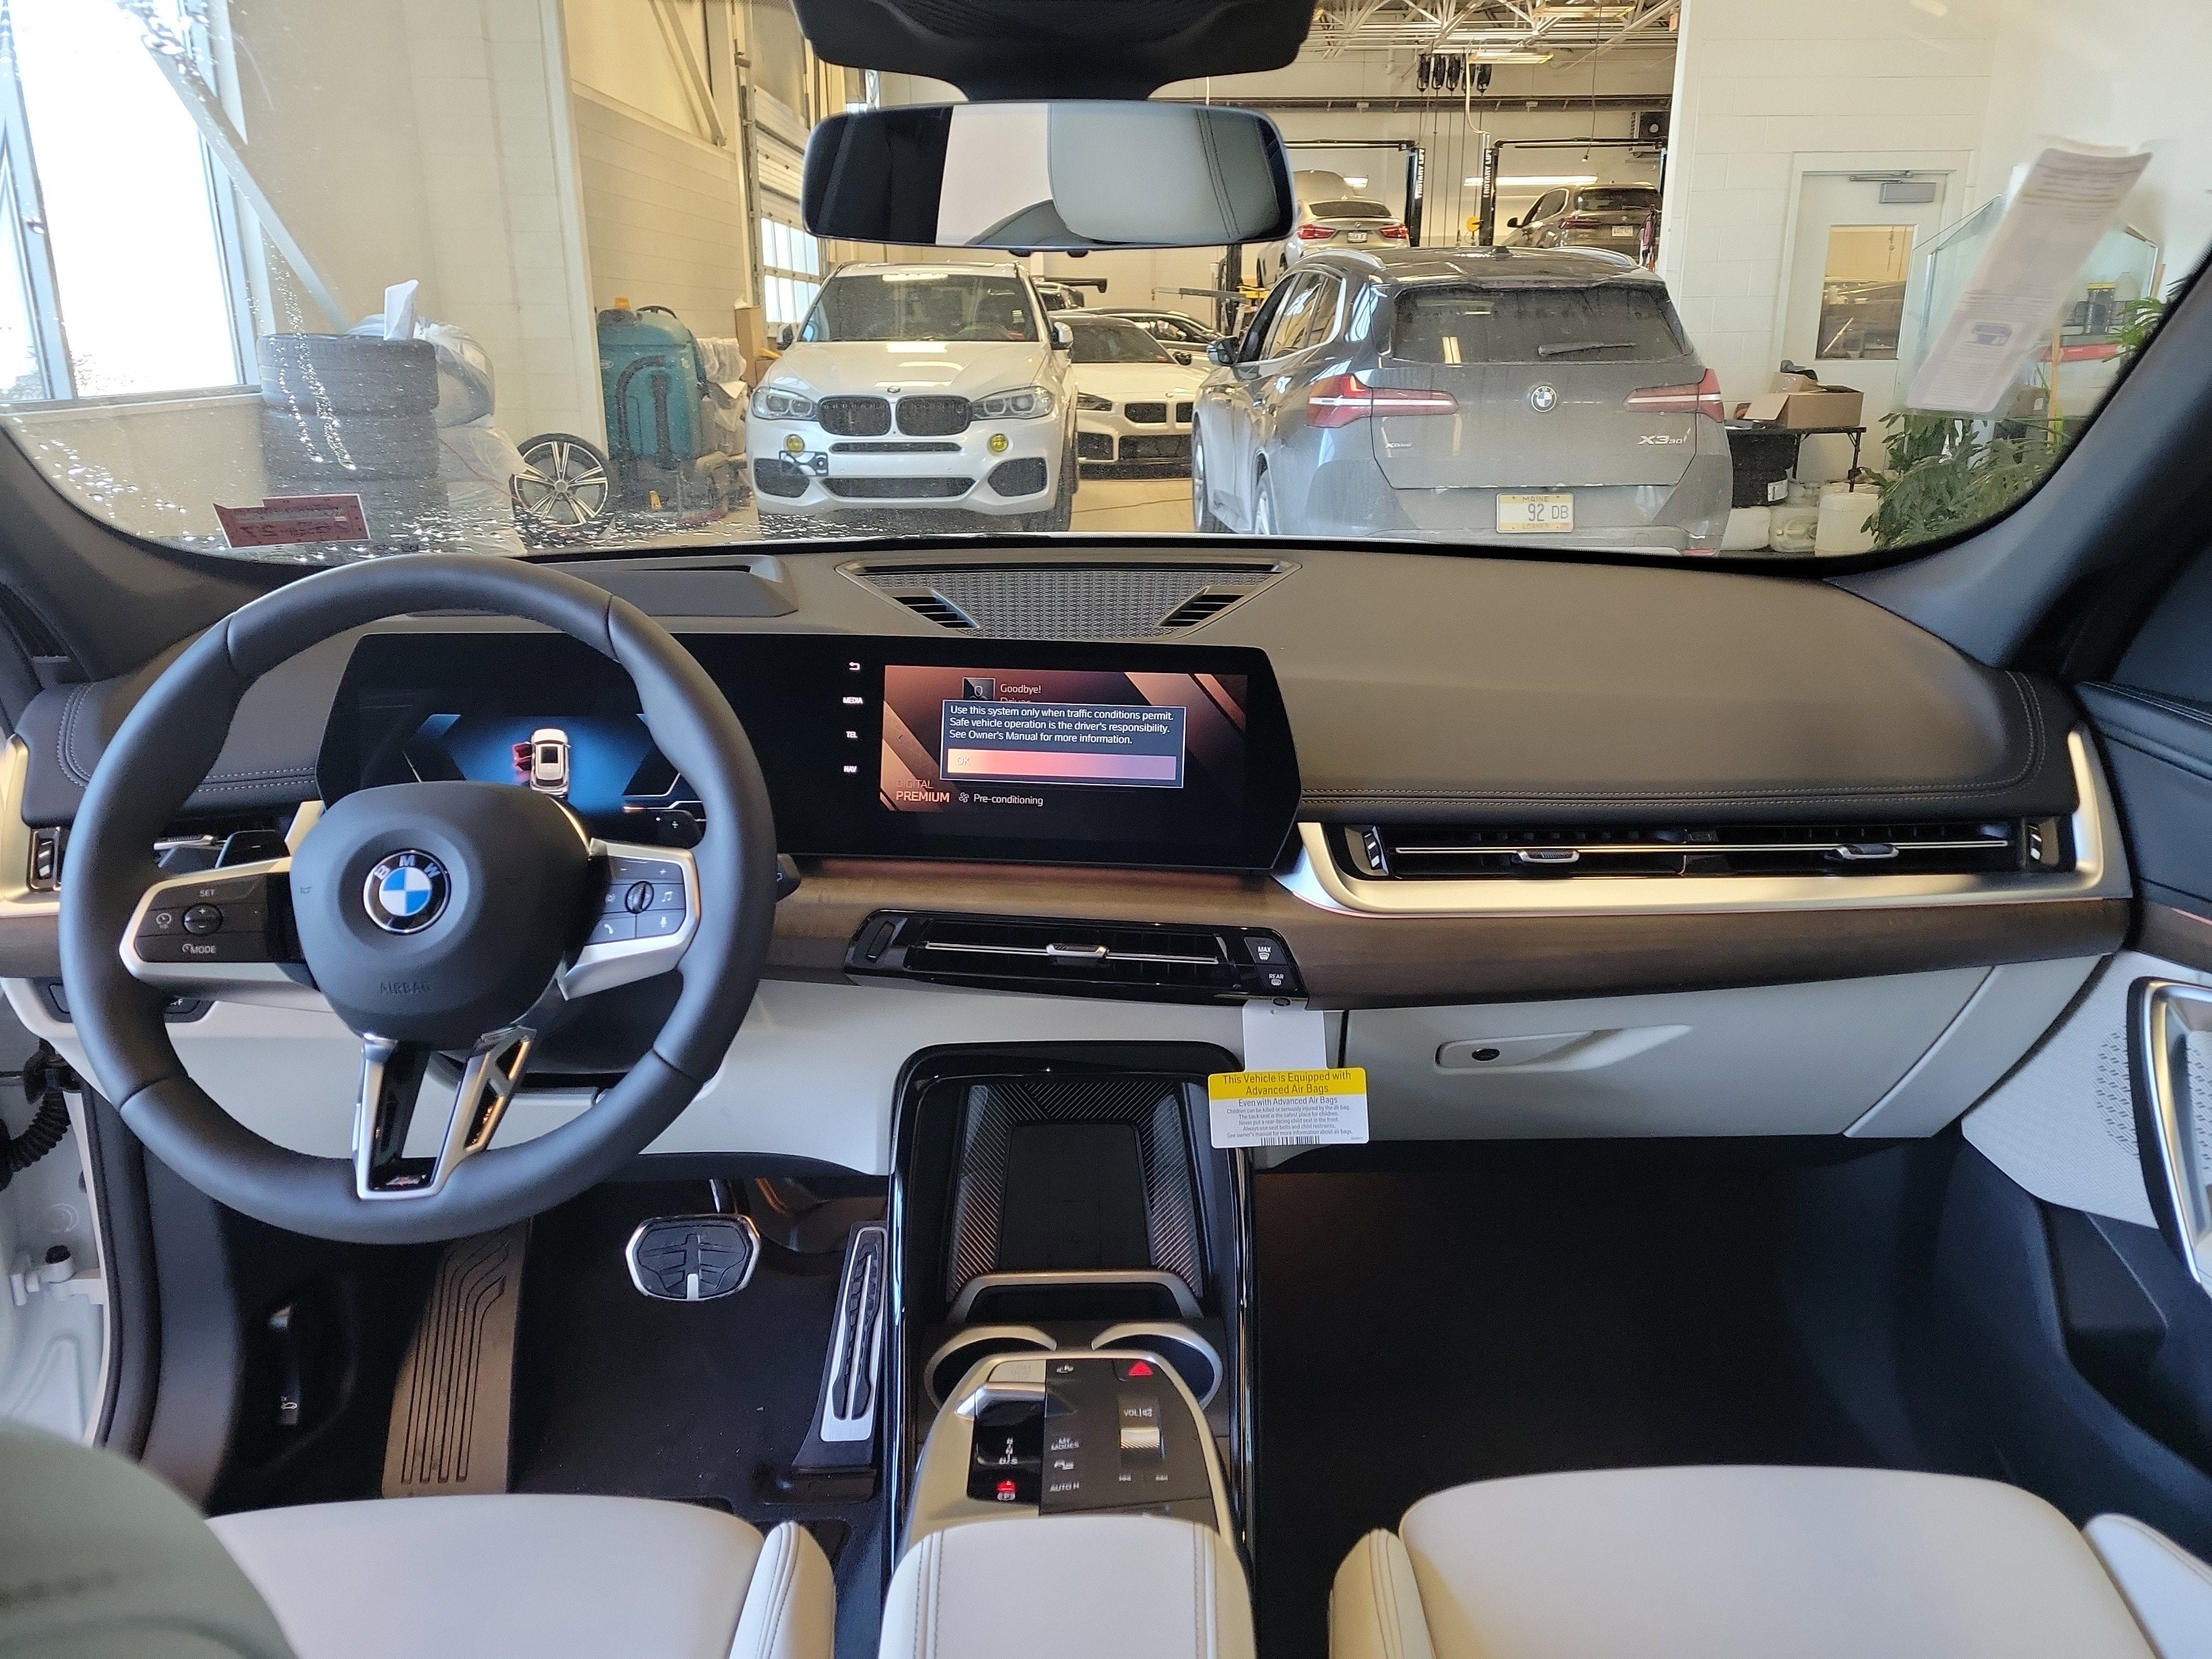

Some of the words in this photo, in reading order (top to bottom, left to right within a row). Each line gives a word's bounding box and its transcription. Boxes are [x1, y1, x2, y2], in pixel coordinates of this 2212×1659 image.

[1528, 503, 1545, 521] 92
[1552, 505, 1568, 519] DB
[1000, 684, 1041, 695] Goodbye!
[950, 705, 968, 714] Use
[970, 706, 986, 714] this
[987, 707, 1019, 717] system
[1021, 708, 1040, 718] only
[1041, 709, 1065, 717] when
[1067, 709, 1092, 718] traffic
[1094, 710, 1141, 720] conditions
[1142, 712, 1174, 721] permit.
[950, 718, 970, 726] Safe
[971, 719, 1002, 727] vehicle
[1004, 720, 1046, 729] operation
[1048, 721, 1056, 729] is
[1057, 721, 1073, 730] the
[1074, 722, 1107, 731] driver's
[1109, 723, 1170, 734] responsibility.
[949, 730, 966, 738] See
[968, 730, 1004, 740] Owner's
[1006, 732, 1038, 741] Manual
[1040, 732, 1053, 741] for
[1054, 734, 1078, 742] more
[1080, 734, 1133, 744] information.
[957, 756, 970, 765] OK
[897, 779, 934, 789] DIGITAL
[896, 791, 950, 803] PREMIUM
[974, 794, 1043, 806] Pre-conditioning
[374, 854, 441, 880] BMW
[190, 945, 216, 954] MODE
[1223, 1075, 1241, 1085] This
[1243, 1073, 1276, 1083] Vehicle
[1278, 1073, 1285, 1082] is
[1288, 1071, 1330, 1083] Equipped
[1332, 1070, 1351, 1080] with
[1246, 1085, 1289, 1096] Advanced
[1292, 1084, 1304, 1094] Air
[1306, 1084, 1329, 1095] Bags
[1273, 1097, 1307, 1105] Advanced
[1320, 1096, 1338, 1105] Bags
[1124, 1408, 1138, 1417] VOL
[1050, 1483, 1071, 1492] AUTO
